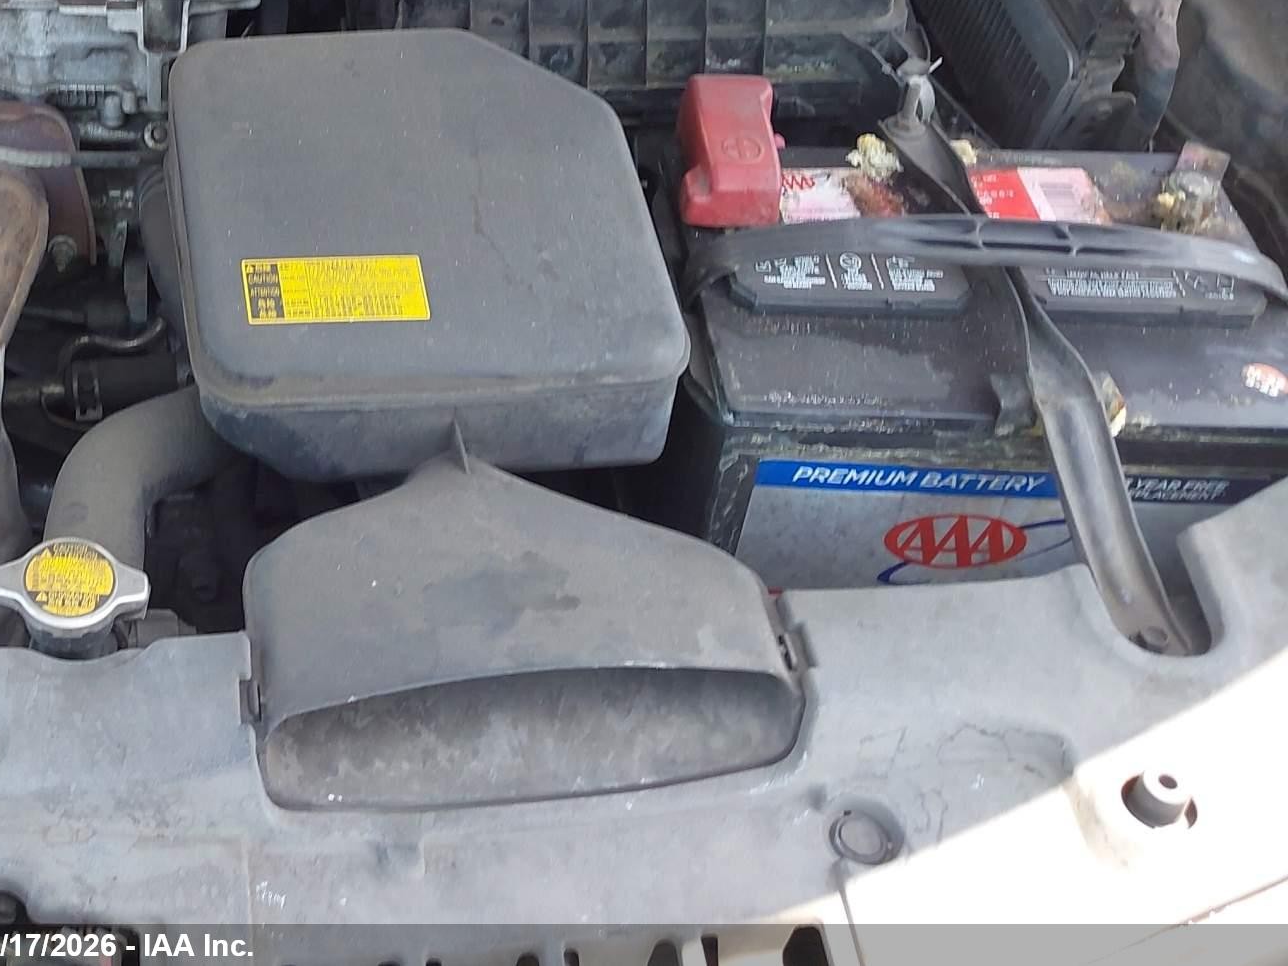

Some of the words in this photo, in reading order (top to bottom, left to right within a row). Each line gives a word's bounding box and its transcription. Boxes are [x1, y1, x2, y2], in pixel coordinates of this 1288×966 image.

[792, 466, 918, 487] PREMIUM
[919, 471, 1046, 494] BATTERY
[895, 515, 1009, 565] AAA
